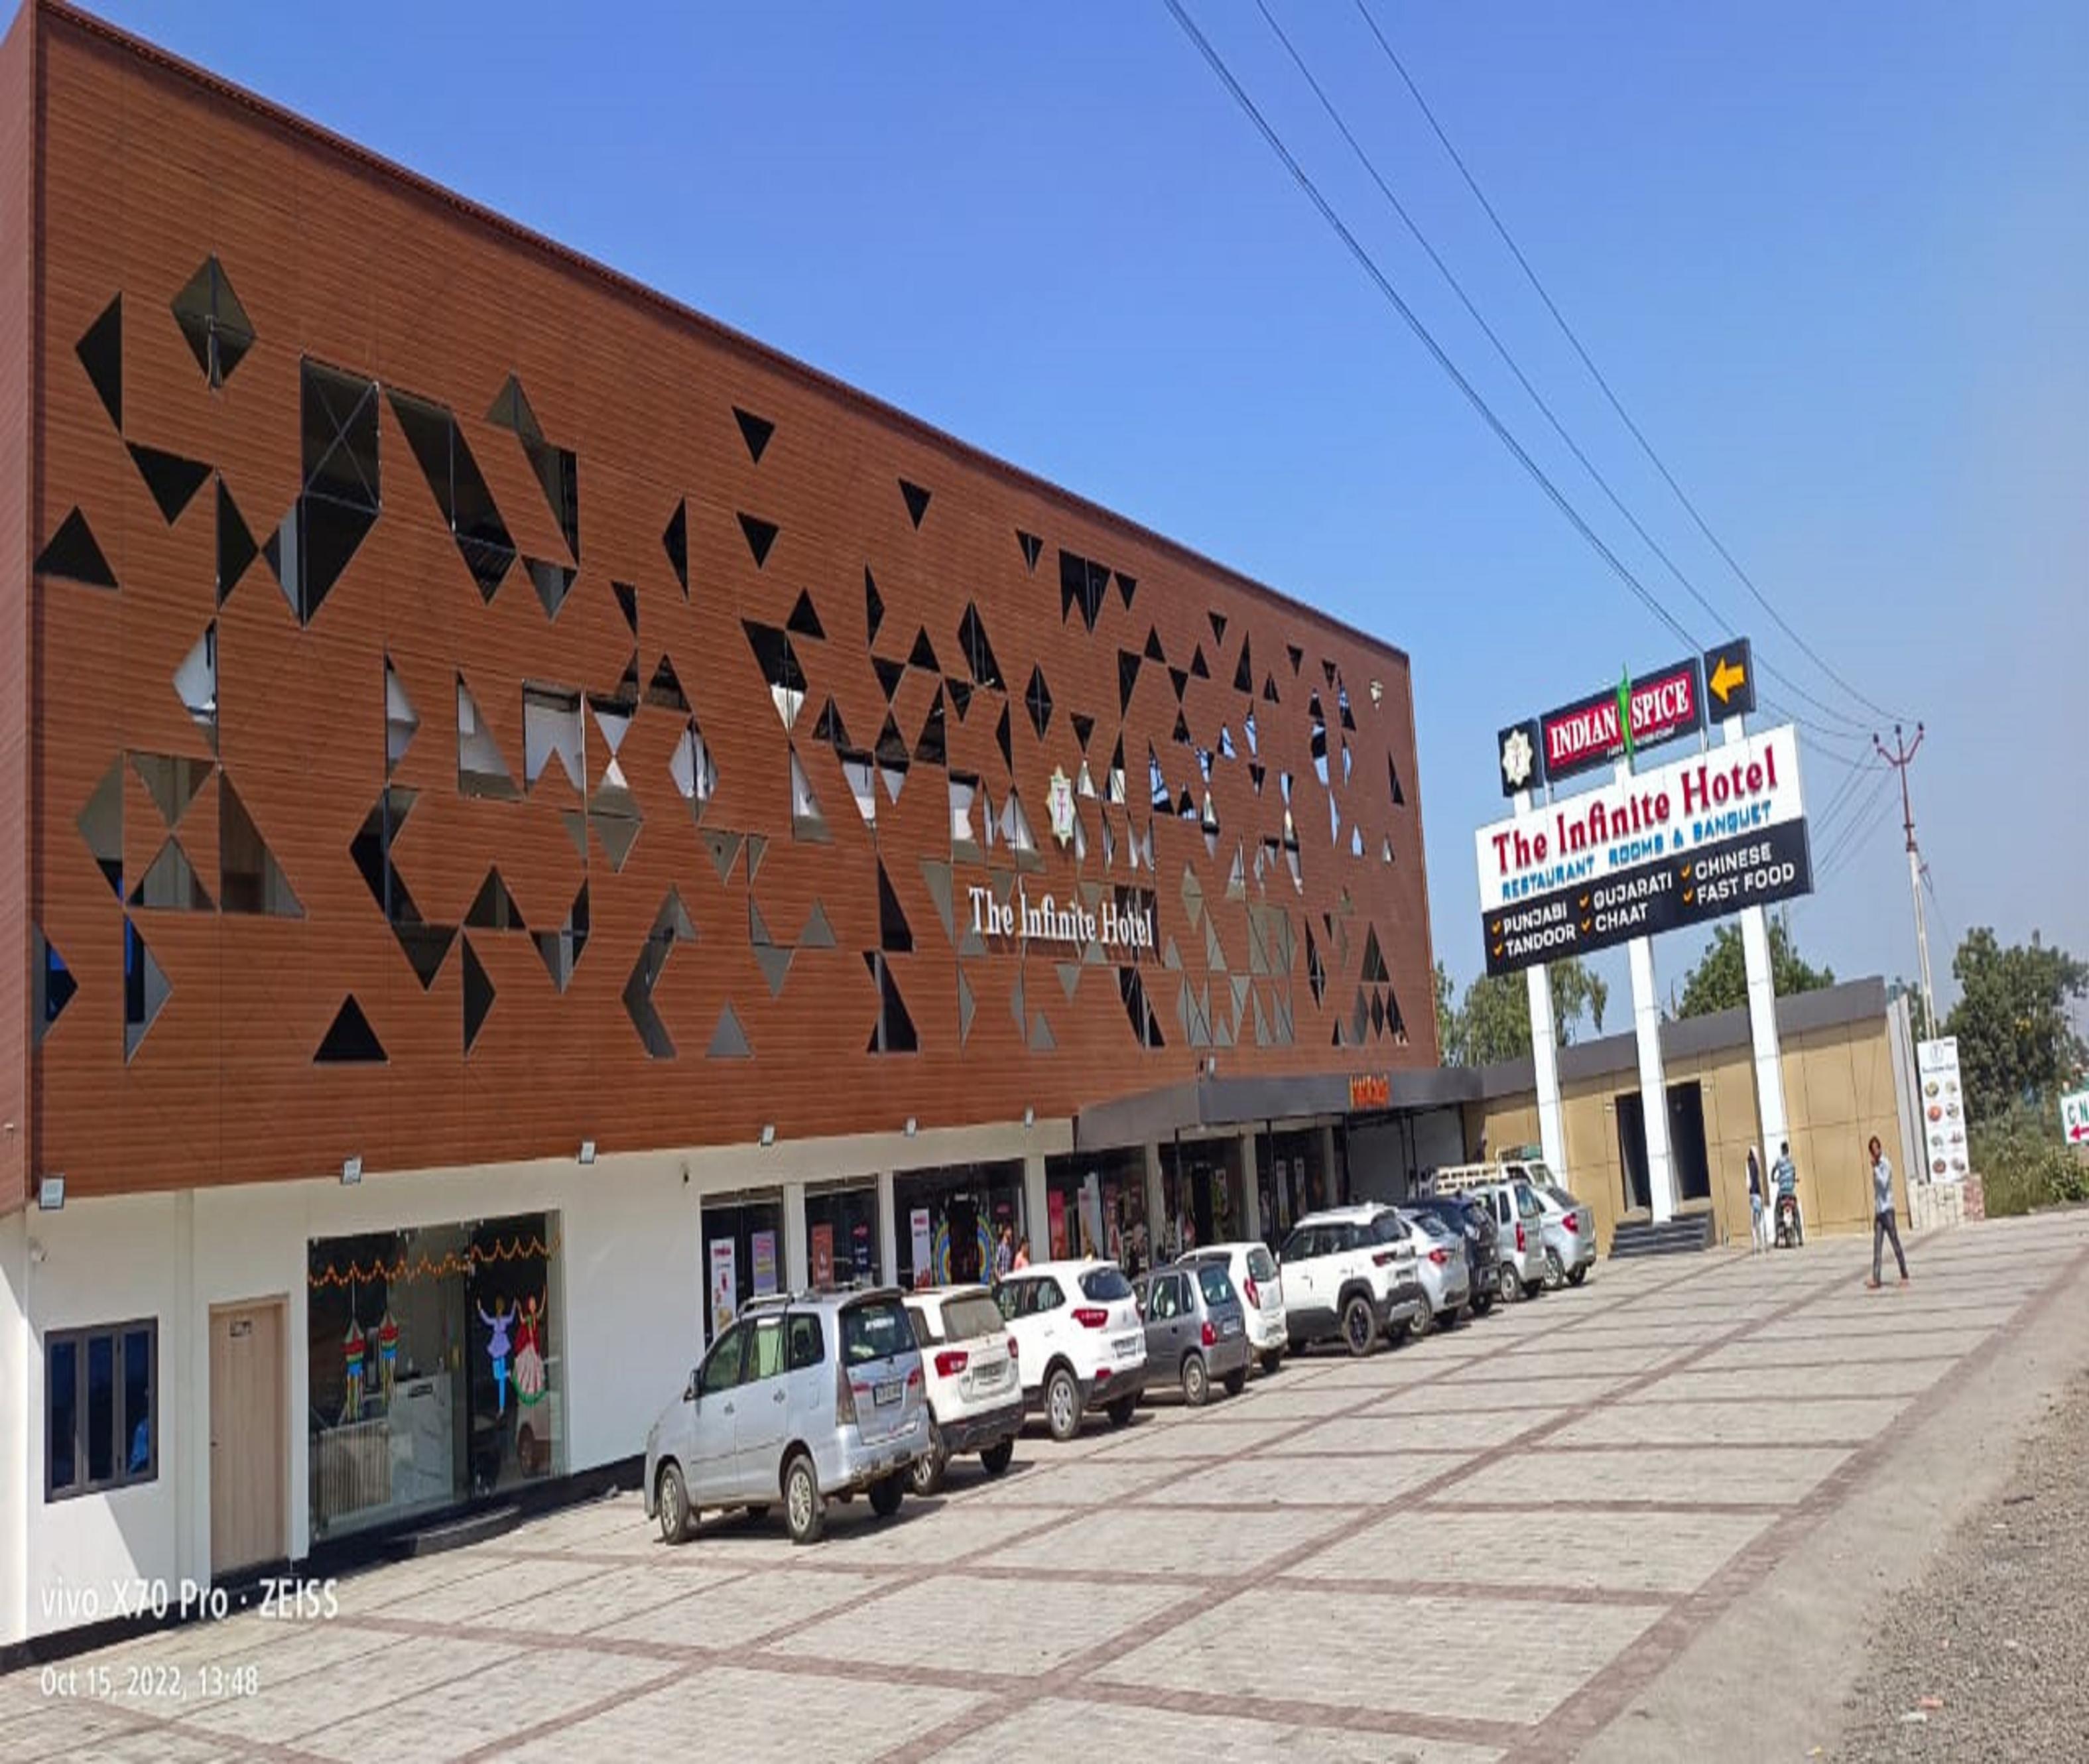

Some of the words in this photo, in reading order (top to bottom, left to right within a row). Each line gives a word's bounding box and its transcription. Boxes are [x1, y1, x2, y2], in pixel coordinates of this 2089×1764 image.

[1550, 704, 1617, 759] INDIAN
[1631, 678, 1689, 729] SPICE
[1493, 831, 1547, 876] The
[1556, 790, 1669, 855] Infinite
[1680, 744, 1777, 817] Hotel
[1502, 855, 1595, 900] RESTAURANT
[1608, 836, 1663, 869] ROOMS
[1692, 800, 1772, 842] BANQUET
[1695, 842, 1773, 881] CHINESE
[1593, 872, 1673, 909] GUJARATI
[1696, 876, 1739, 905] FAST
[1743, 863, 1795, 891] FOOD
[969, 887, 1015, 936] The
[1020, 893, 1096, 941] Infinite
[1101, 901, 1153, 947] Hotel
[1503, 902, 1567, 934] PUNJABI
[1595, 903, 1649, 932] CHAAT
[1505, 924, 1576, 957] TANDOOR
